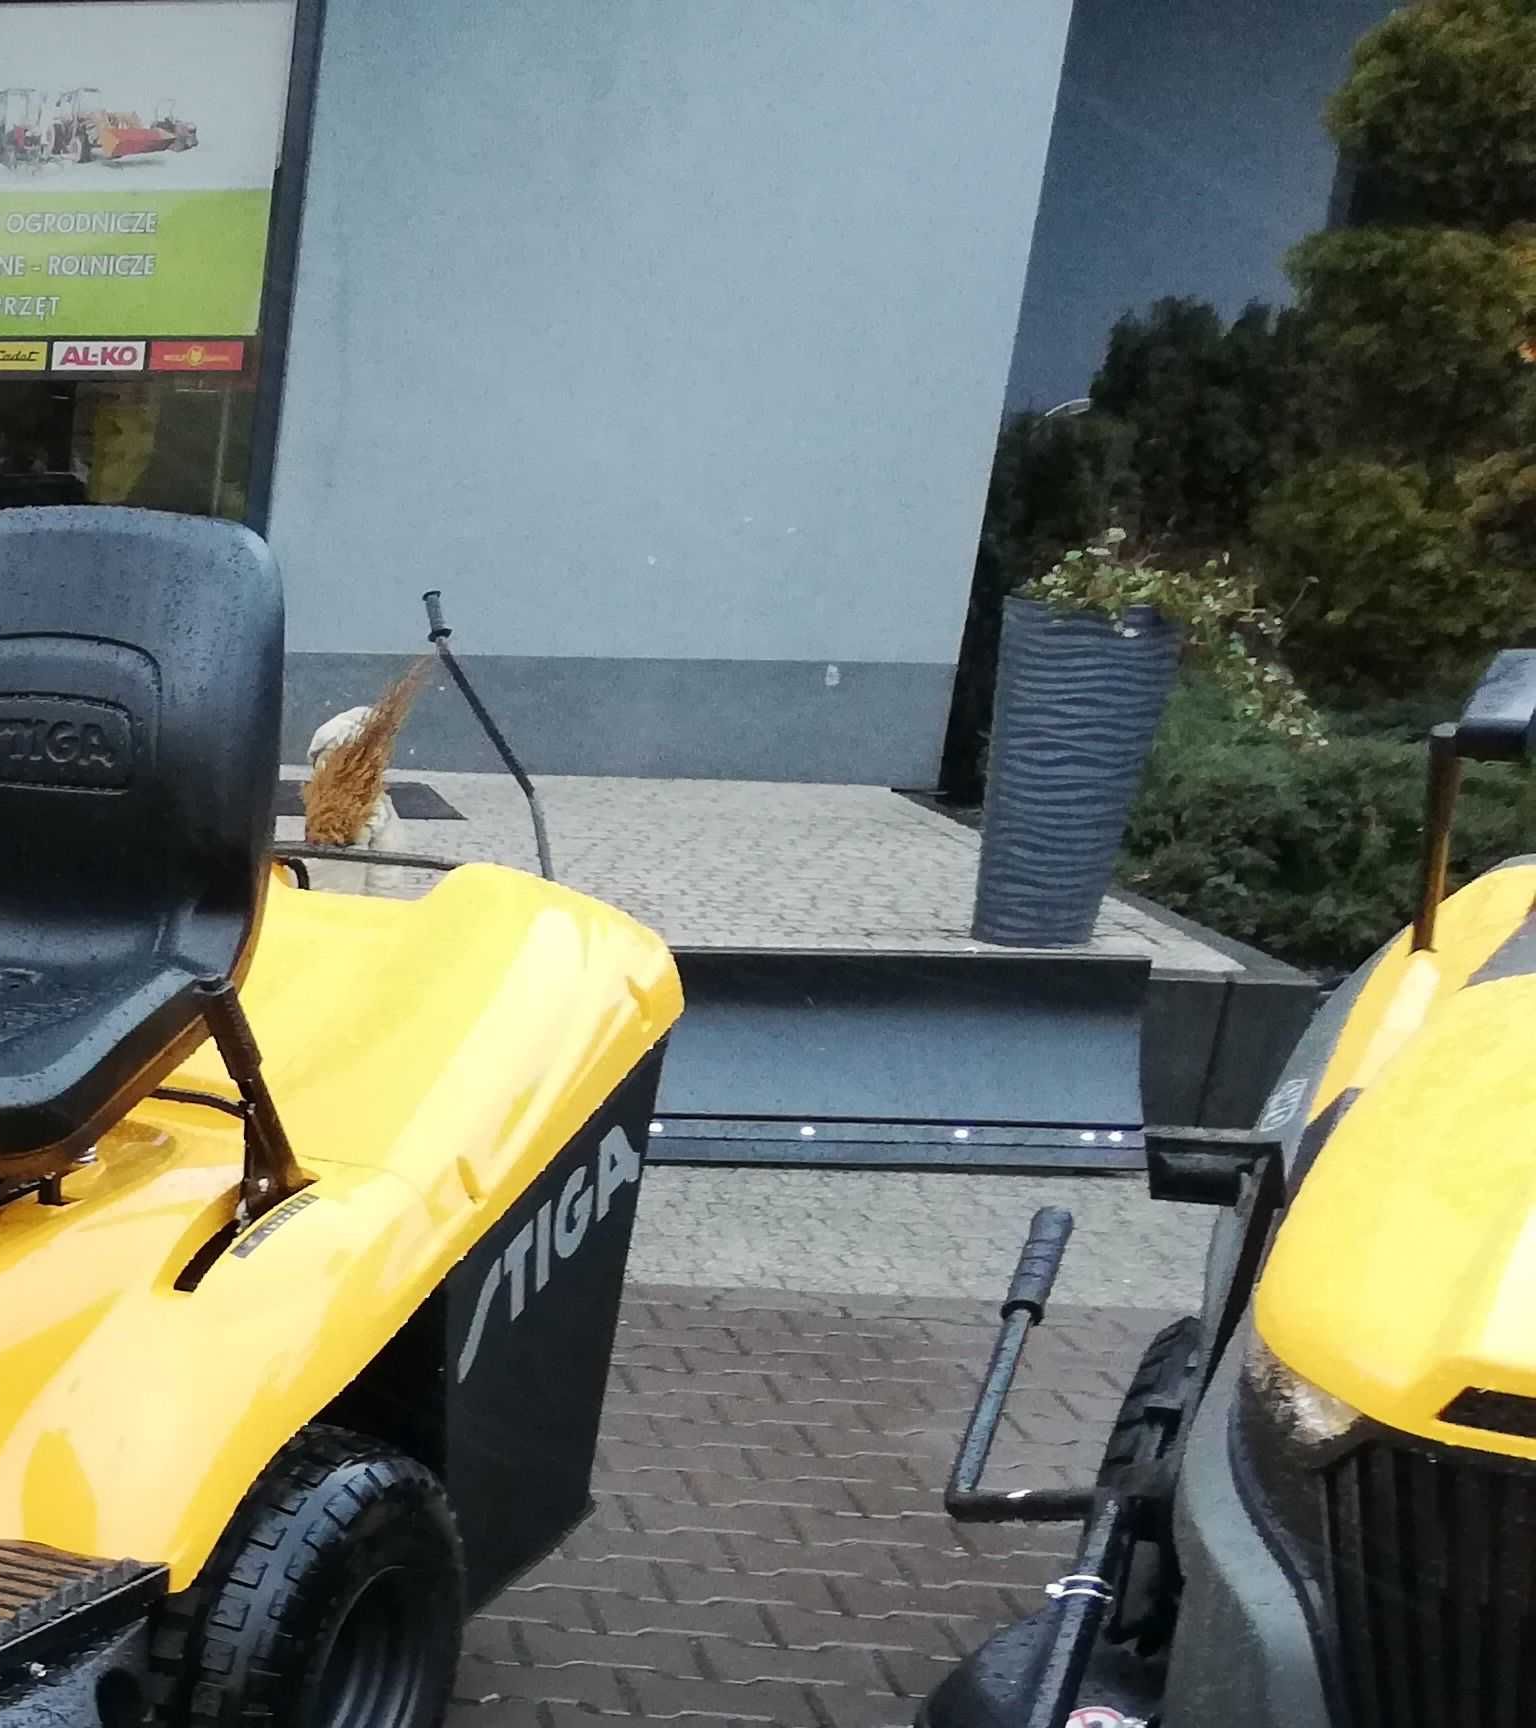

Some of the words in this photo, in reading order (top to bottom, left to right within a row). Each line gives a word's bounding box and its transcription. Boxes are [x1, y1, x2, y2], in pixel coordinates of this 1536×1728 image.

[6, 211, 158, 234] OGRODNICZE
[47, 254, 157, 276] ROLNICZE
[59, 345, 139, 367] AL-KO
[456, 1124, 641, 1384] STIGA
